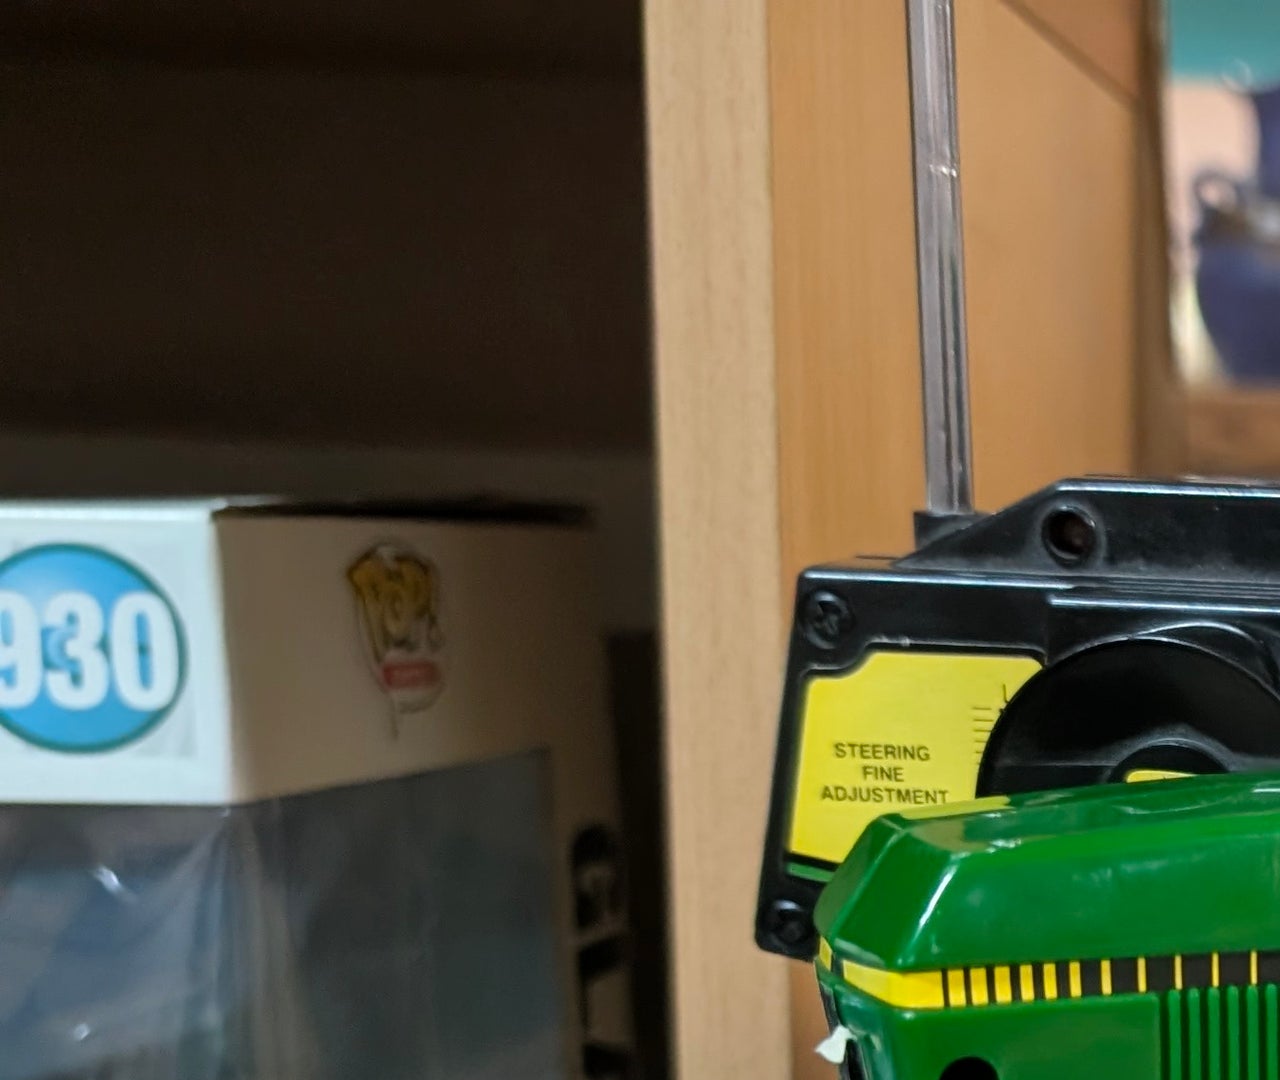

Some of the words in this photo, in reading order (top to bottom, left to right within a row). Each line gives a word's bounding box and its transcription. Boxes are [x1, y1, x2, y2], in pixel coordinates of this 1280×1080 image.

[0, 589, 180, 712] 930
[833, 742, 931, 762] STEERING
[861, 765, 905, 783] FINE
[821, 785, 949, 805] ADJUSTMENT
